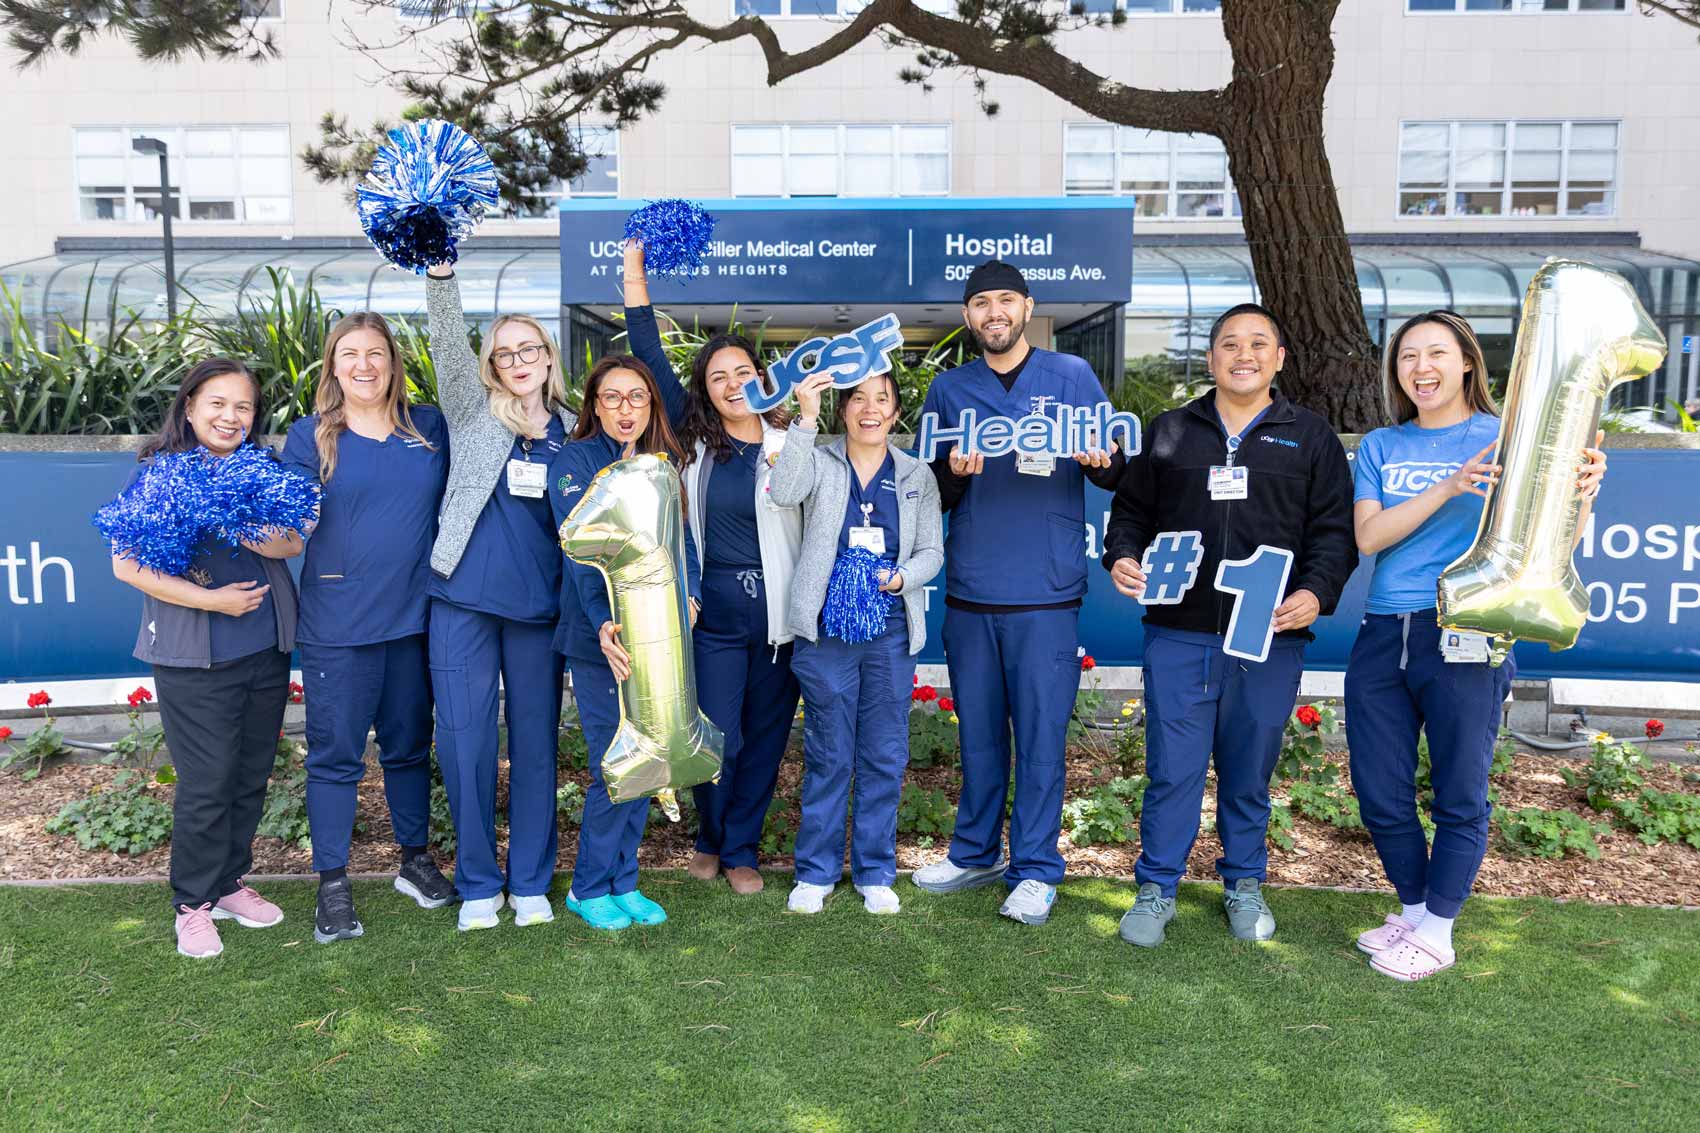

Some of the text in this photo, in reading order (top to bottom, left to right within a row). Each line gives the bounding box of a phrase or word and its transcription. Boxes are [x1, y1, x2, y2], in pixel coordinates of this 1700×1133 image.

[589, 240, 625, 258] UCS
[746, 240, 814, 258] Medical
[818, 240, 877, 258] Center
[945, 233, 1053, 261] Hospital
[590, 265, 608, 276] AT
[718, 265, 788, 276] HEIGHTS
[1019, 267, 1067, 281] assus
[1069, 264, 1106, 281] Ave.
[740, 312, 905, 413] UCSF
[918, 401, 1142, 464] Health
[1384, 467, 1461, 492] UCS
[0, 541, 76, 605] th
[1585, 581, 1648, 623] 05
